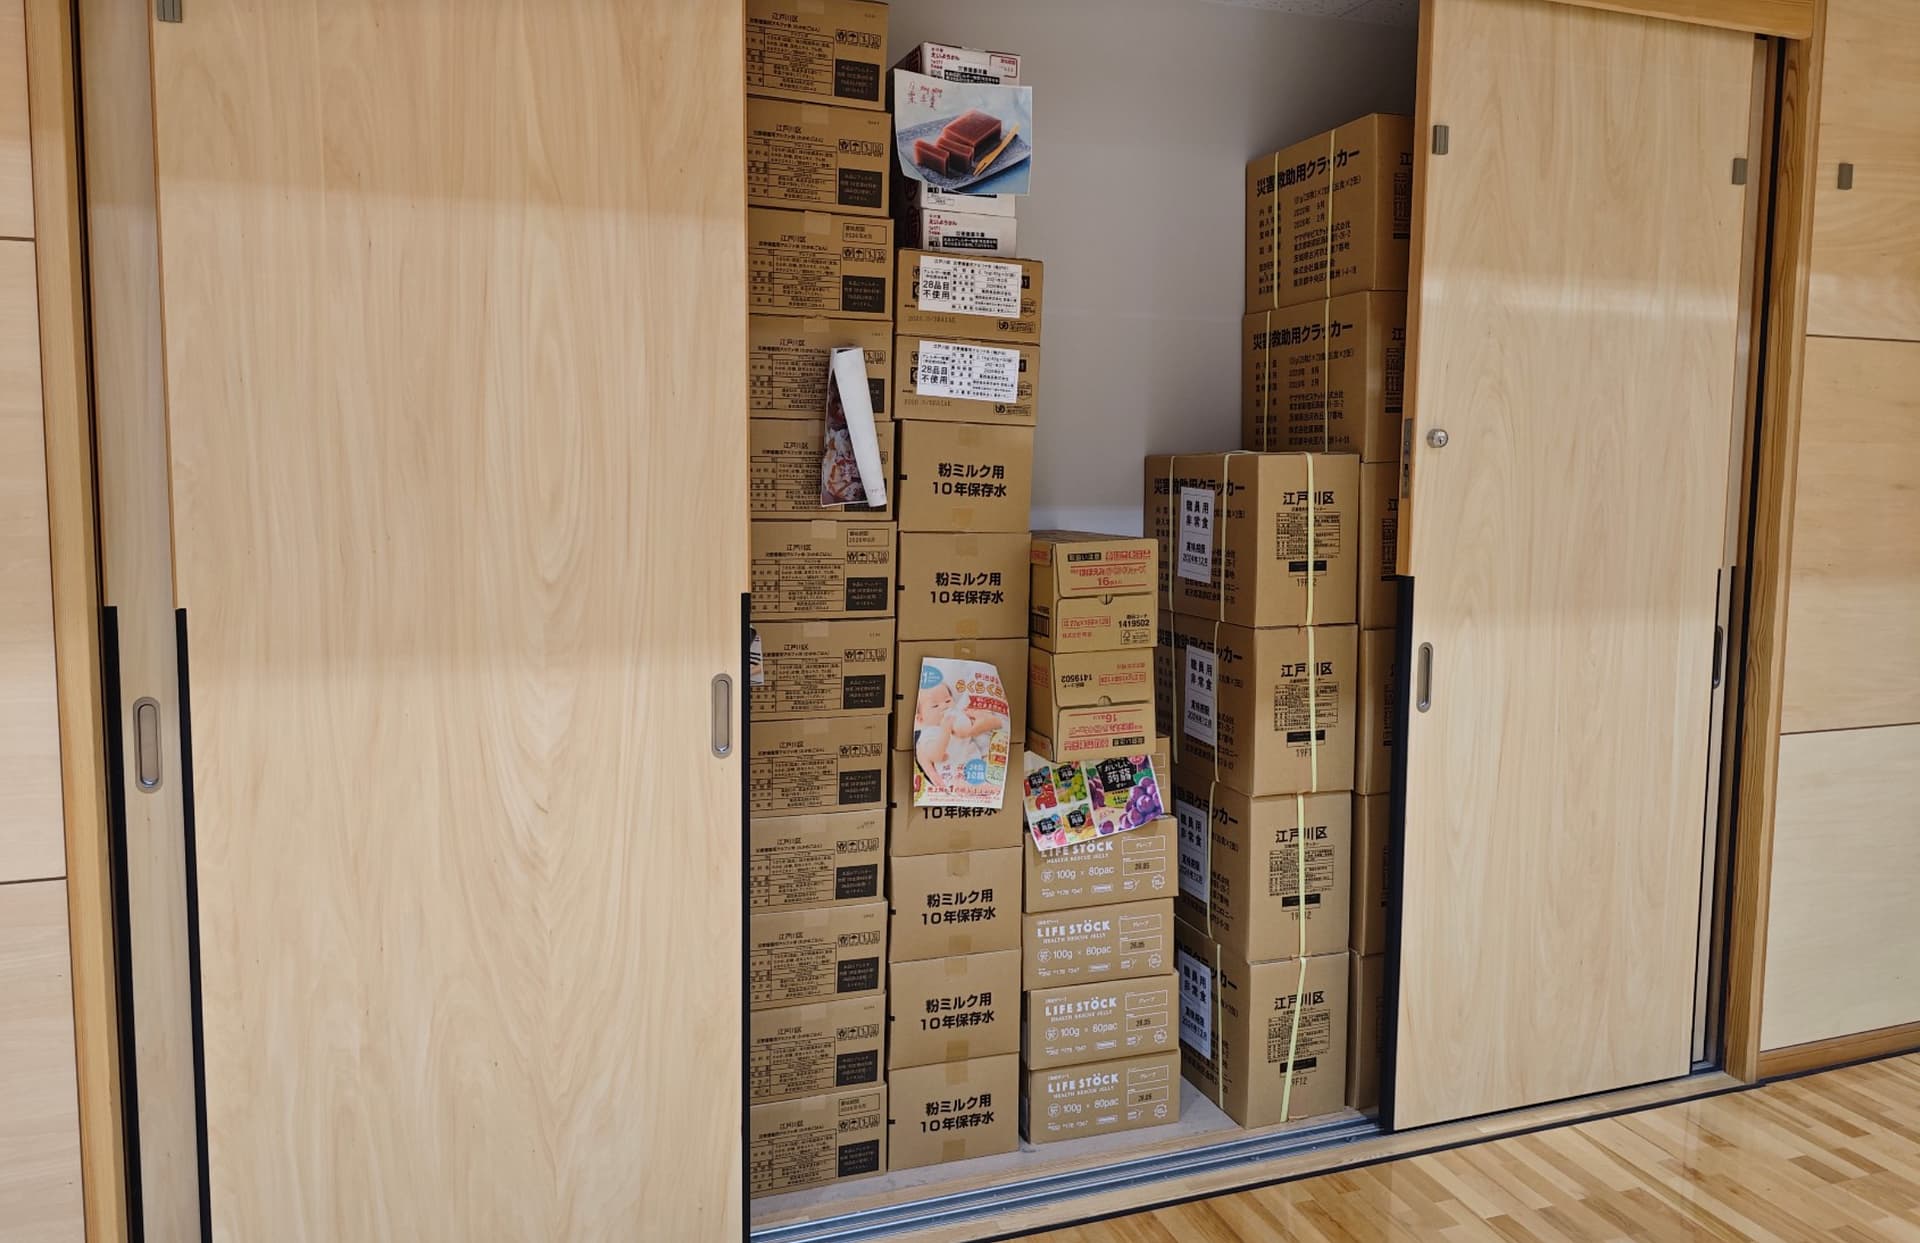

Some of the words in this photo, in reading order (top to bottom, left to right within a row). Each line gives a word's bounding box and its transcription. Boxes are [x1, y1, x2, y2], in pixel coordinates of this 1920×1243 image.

[922, 280, 950, 290] 28品目
[922, 290, 950, 300] 不使用
[921, 365, 948, 375] 28品目
[920, 374, 948, 384] 不使用
[938, 463, 1004, 479] 粉ミルク用
[932, 482, 1007, 498] 10年保存水
[1283, 491, 1334, 505] 江戸川区
[1186, 500, 1209, 514] 職員用
[1186, 515, 1208, 529] 非常食
[936, 572, 1002, 586] 粉ミルク用
[930, 591, 1004, 604] 10年保存水
[1118, 620, 1150, 628] 1419502
[1190, 658, 1212, 677] 職員用
[1060, 674, 1093, 683] 1419502
[1190, 673, 1212, 692] 非常食
[1276, 826, 1328, 843] 江戸川区
[1041, 846, 1069, 858] LIFE
[1072, 840, 1114, 855] STÖCK
[1057, 870, 1076, 880] 100g
[1088, 867, 1114, 877] 80pac
[927, 888, 993, 908] 粉ミルク用
[922, 905, 996, 926] 10年保存水
[1037, 924, 1066, 938] LIFE
[1070, 920, 1110, 934] STÖCK
[1054, 950, 1072, 960] 100g
[1086, 946, 1112, 956] 80pac
[926, 992, 992, 1014] 粉ミルク用
[1045, 1003, 1072, 1016] LIFE
[1077, 996, 1118, 1012] STÖCK
[1274, 991, 1324, 1010] 江戸川区
[920, 1010, 994, 1031] 10年保存水
[1061, 1027, 1080, 1038] 100g
[1092, 1022, 1118, 1034] 80pac
[1048, 1080, 1076, 1093] LIFE
[1079, 1073, 1119, 1089] STÖCK
[925, 1094, 992, 1116] 粉ミルク用
[1064, 1104, 1082, 1114] 100g
[1094, 1098, 1119, 1108] 80pac
[920, 1111, 994, 1133] 10年保存水
